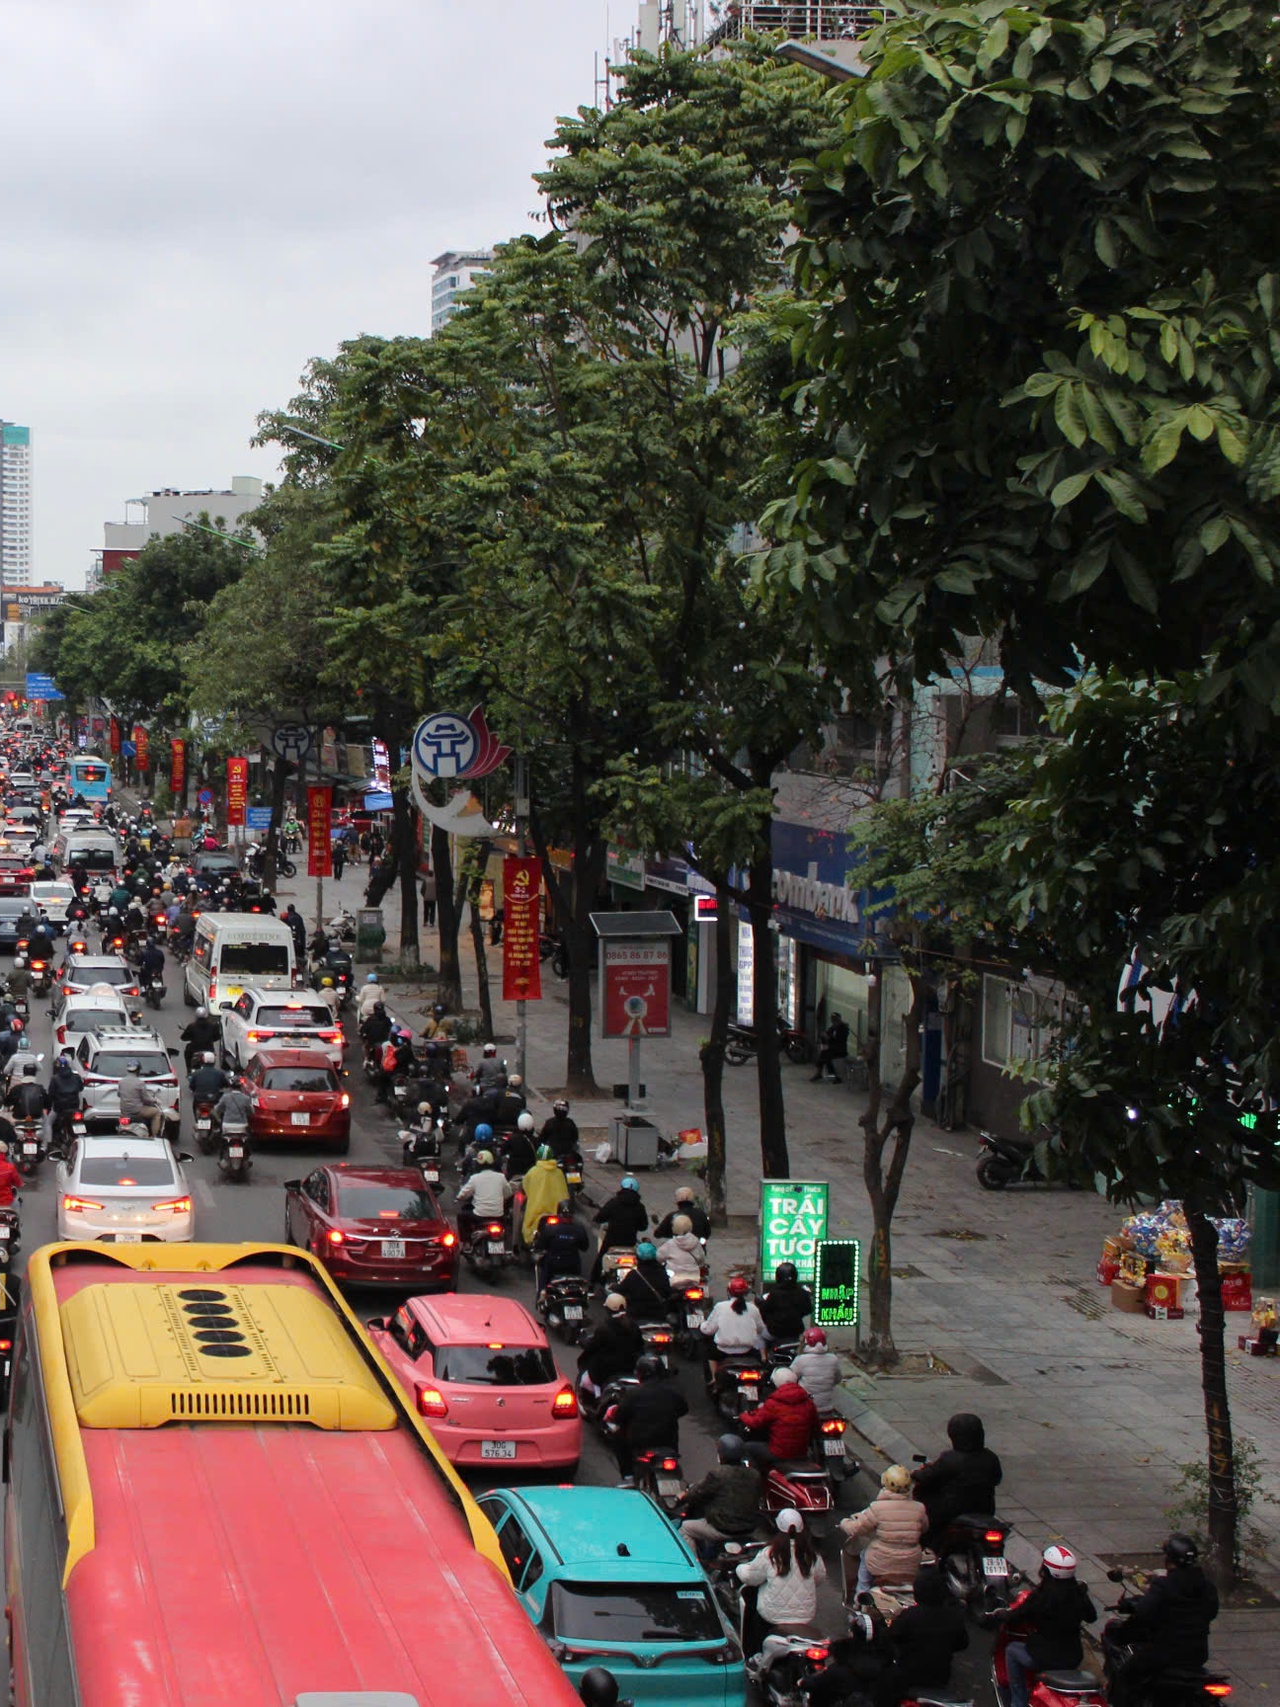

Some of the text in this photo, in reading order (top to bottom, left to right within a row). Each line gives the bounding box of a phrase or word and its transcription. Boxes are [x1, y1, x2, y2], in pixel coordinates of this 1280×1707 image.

[770, 1193, 824, 1215] TRÁI
[769, 1215, 824, 1235] CÂY
[767, 1237, 815, 1256] TƯƠ
[821, 1284, 854, 1303] NHẬP
